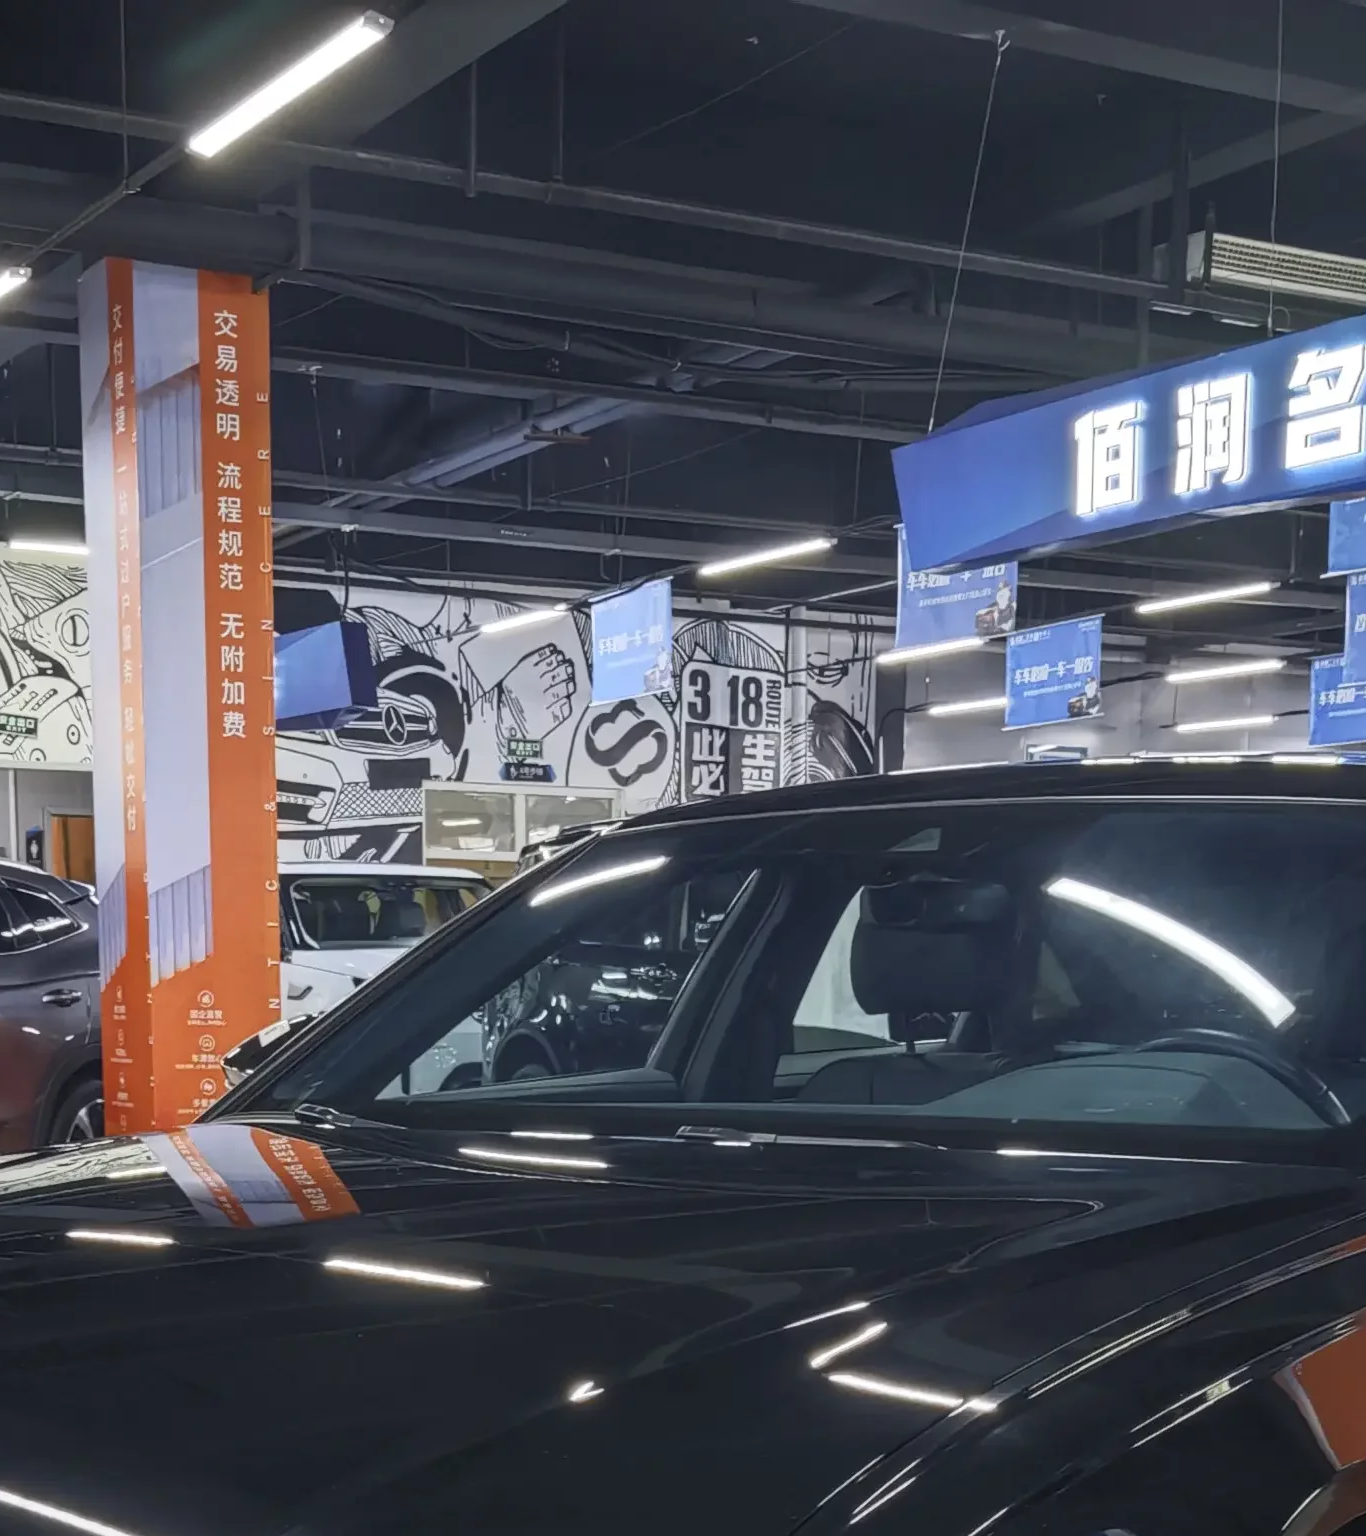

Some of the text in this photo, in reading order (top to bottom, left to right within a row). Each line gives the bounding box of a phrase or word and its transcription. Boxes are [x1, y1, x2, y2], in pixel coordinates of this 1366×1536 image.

[214, 310, 246, 738] 交易透明 流程规范 无附加费
[765, 679, 782, 733] ROUTE
